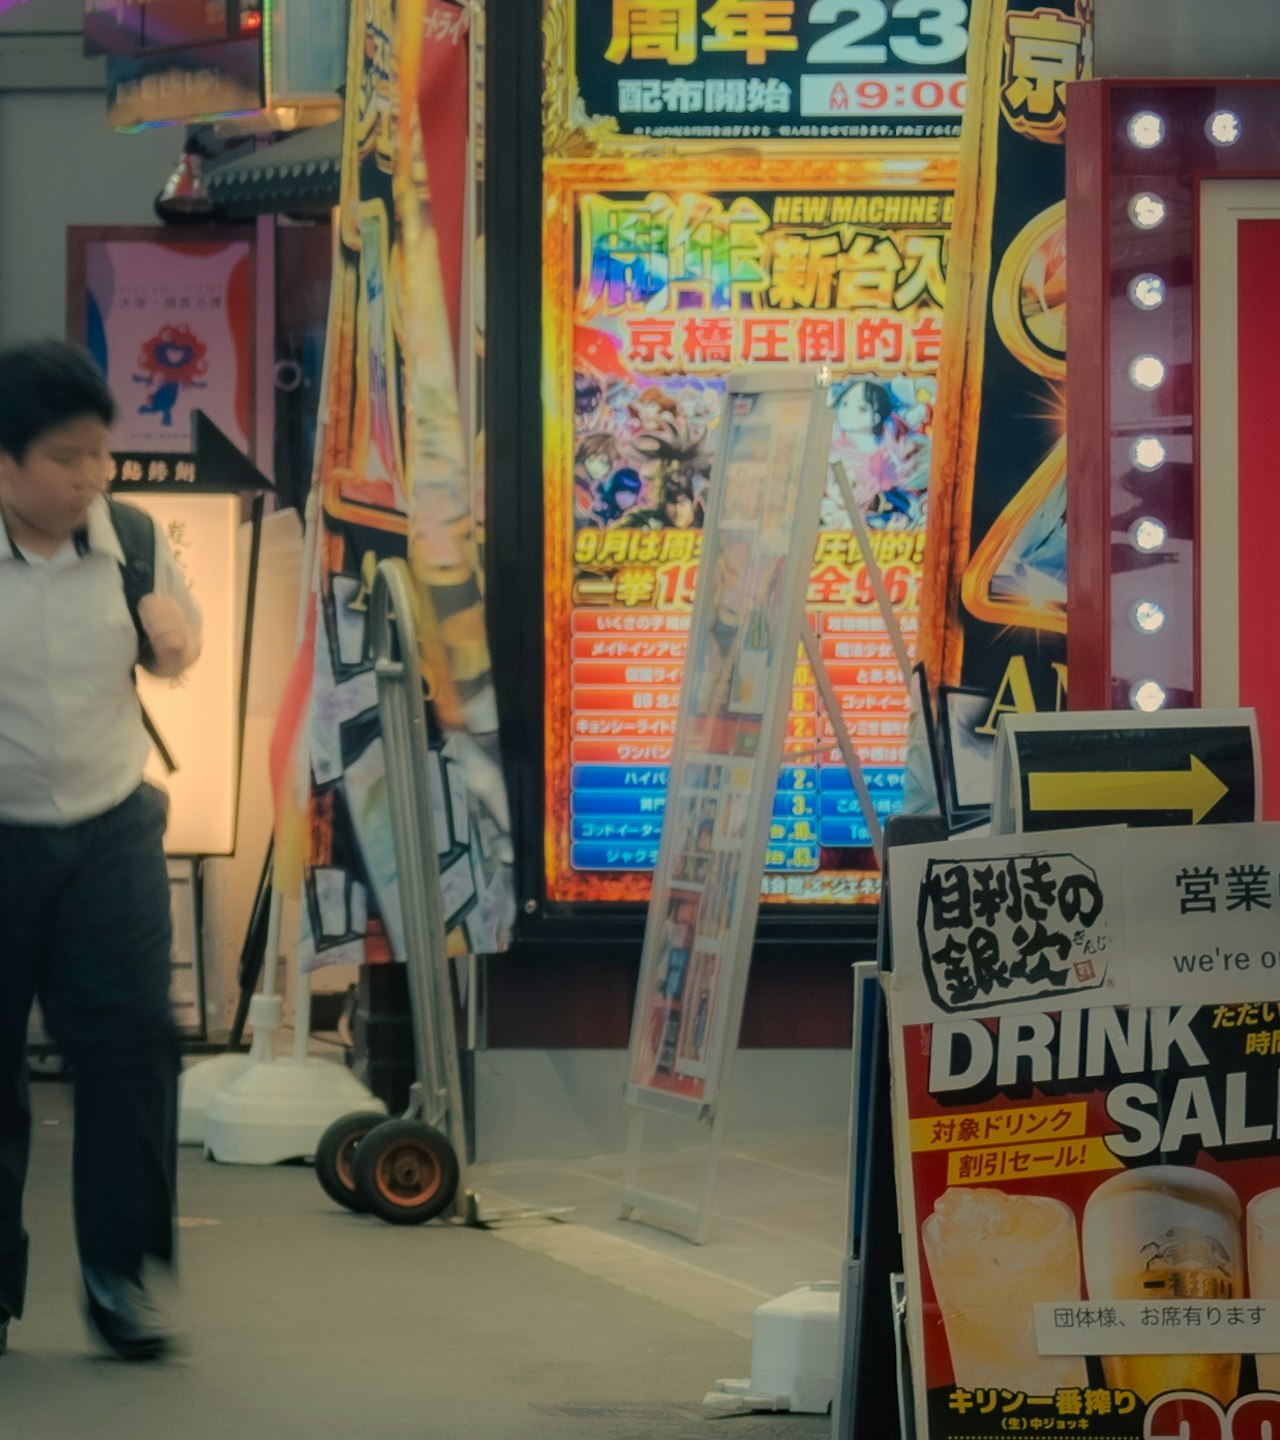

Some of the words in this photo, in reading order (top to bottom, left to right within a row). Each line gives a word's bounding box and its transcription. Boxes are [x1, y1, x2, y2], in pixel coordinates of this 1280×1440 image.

[1005, 10, 1093, 114] 京
[618, 78, 792, 114] 配布開始
[772, 196, 828, 224] NEW
[830, 196, 938, 224] MACHINE
[806, 565, 923, 605] 全96
[929, 857, 1103, 931] 目利きの
[1176, 864, 1280, 915] 営業
[932, 922, 1072, 1003] 銀次
[1173, 950, 1251, 974] we're
[1212, 1003, 1280, 1029] ただい
[929, 1005, 1209, 1093] DRINK
[931, 1109, 1072, 1144] 対象ドリンク
[1104, 1072, 1280, 1157] SAL
[958, 1145, 1087, 1179] 割引セール!
[949, 1389, 1138, 1415] キリン一番搾り
